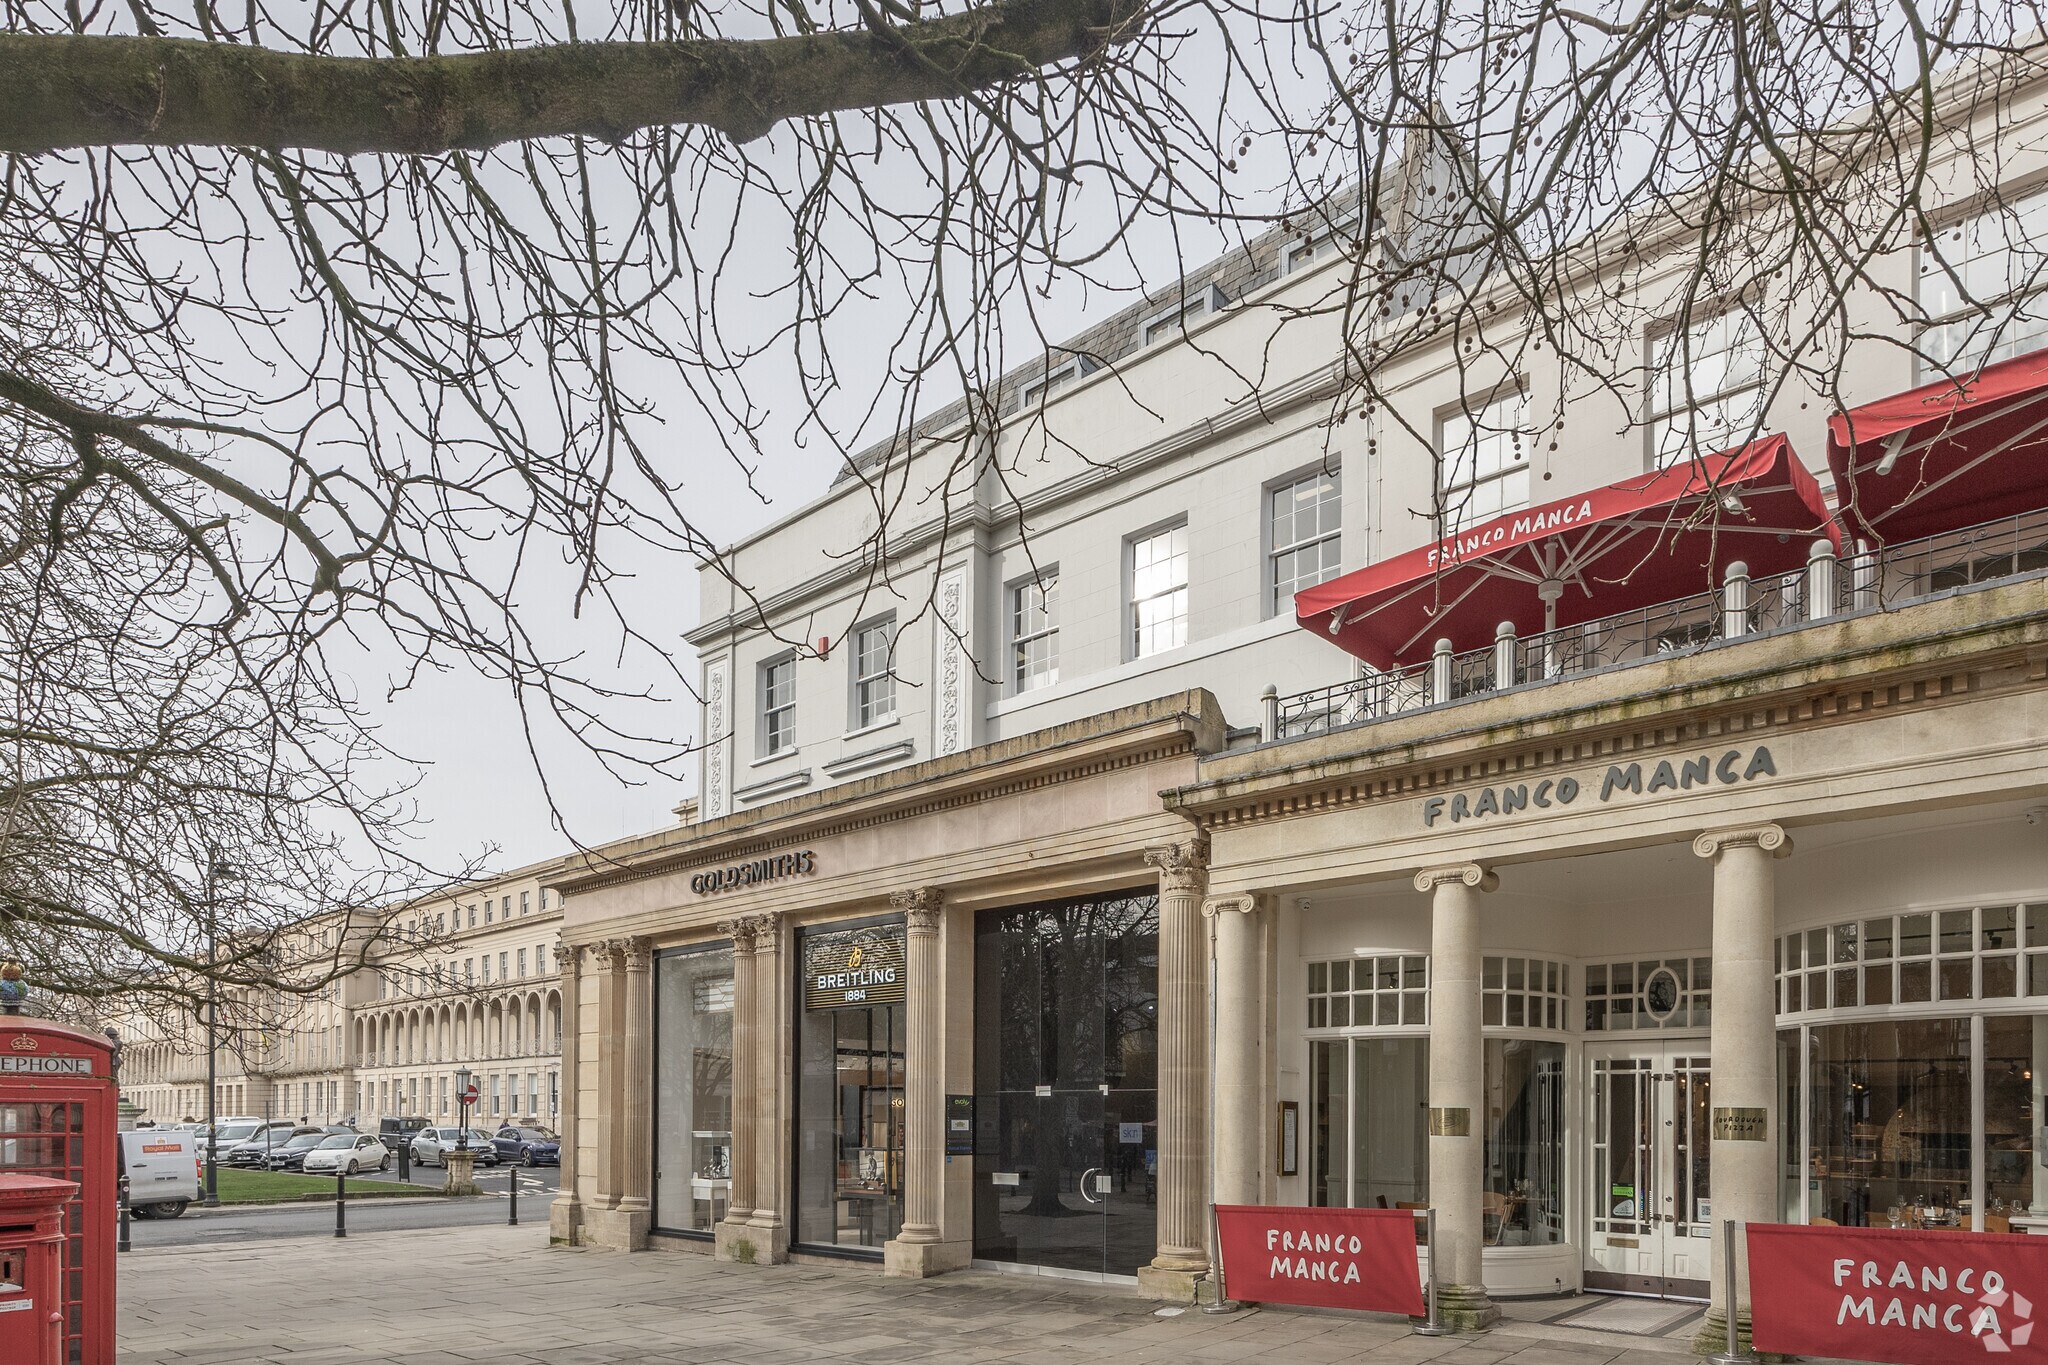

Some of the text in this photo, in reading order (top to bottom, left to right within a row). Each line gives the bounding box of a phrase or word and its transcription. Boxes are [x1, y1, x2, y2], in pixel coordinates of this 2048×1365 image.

[1427, 499, 1592, 567] FRANCO MANCA
[1423, 745, 1777, 827] FRANCO MANCA
[690, 849, 814, 895] GOLDSMITHS
[817, 968, 896, 989] BREITLING
[844, 989, 866, 1002] 1884
[1266, 1229, 1362, 1255] FRANCO
[1269, 1256, 1361, 1284] MANCA
[1833, 1258, 2005, 1295] FRANCO
[1837, 1294, 2002, 1336] MANCA
